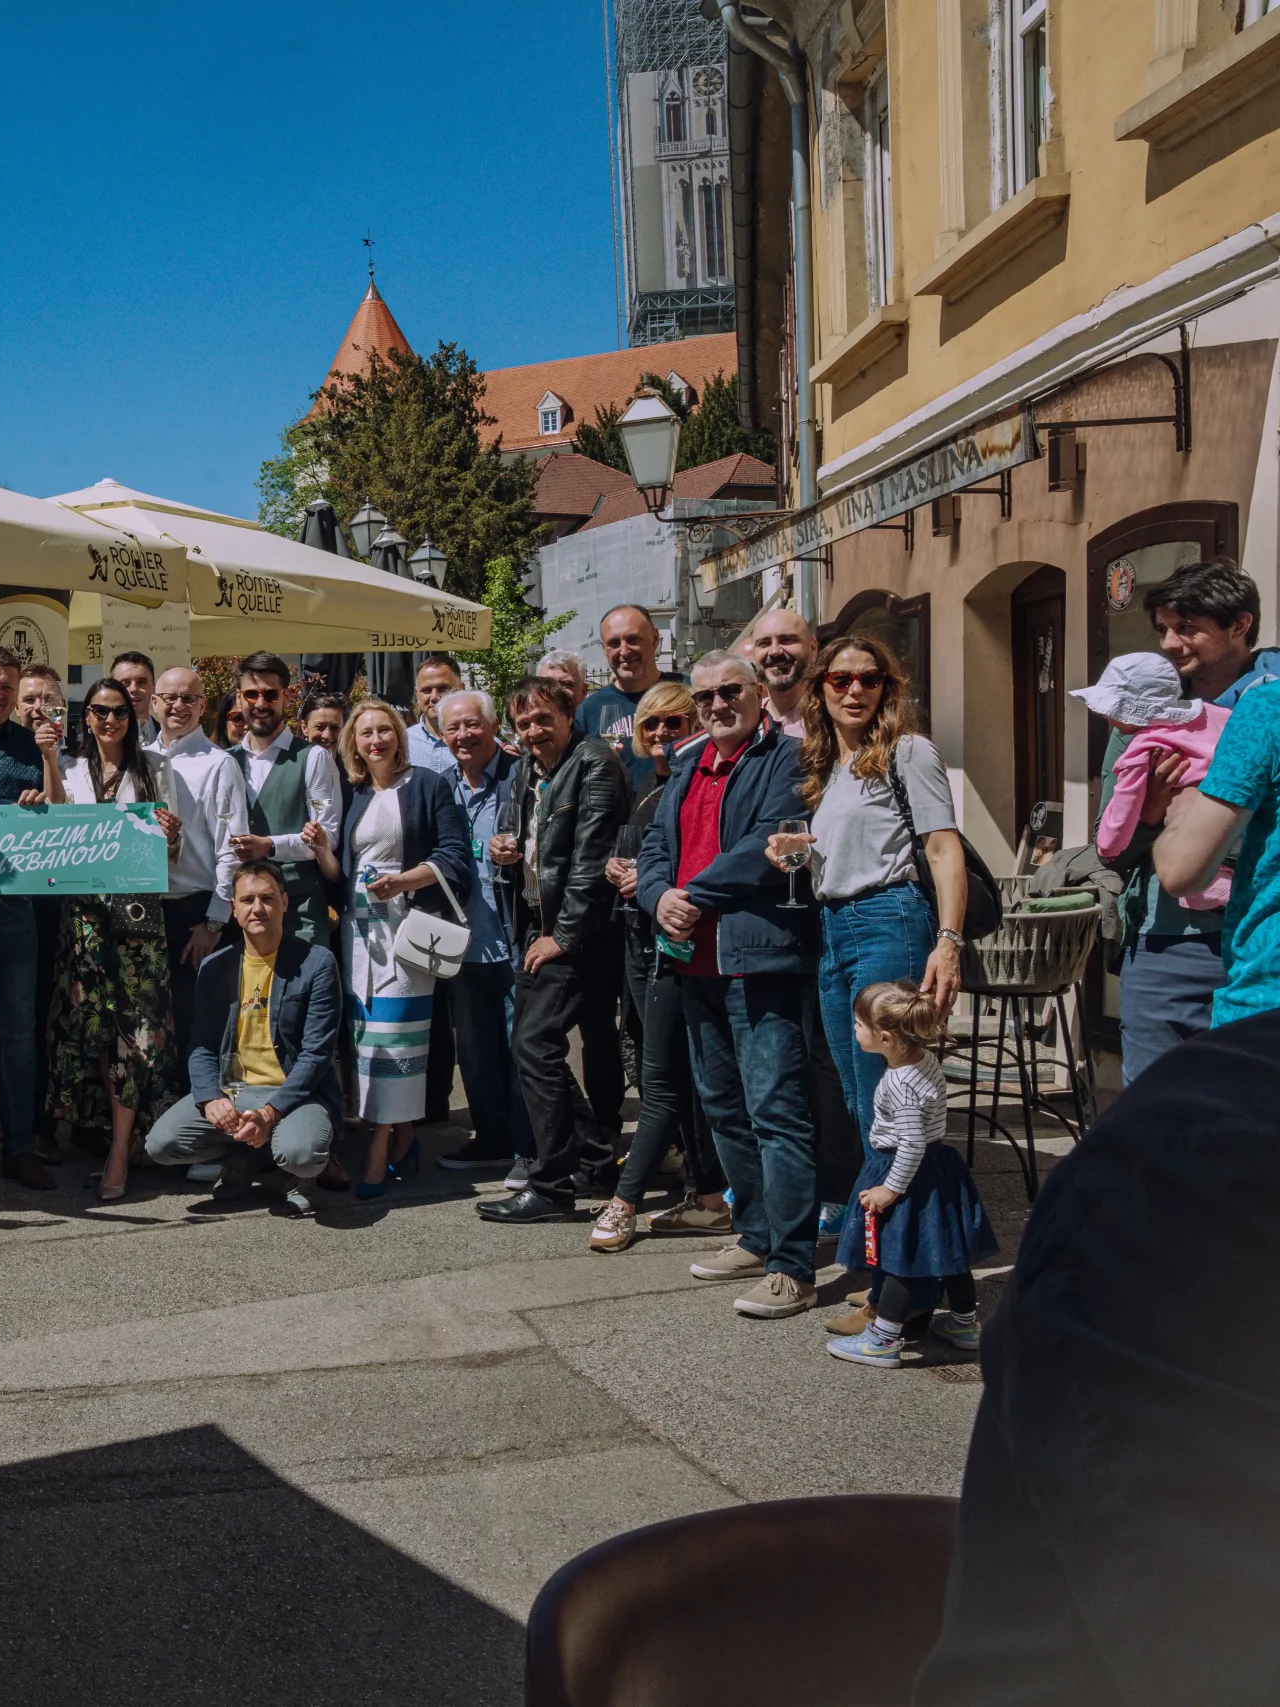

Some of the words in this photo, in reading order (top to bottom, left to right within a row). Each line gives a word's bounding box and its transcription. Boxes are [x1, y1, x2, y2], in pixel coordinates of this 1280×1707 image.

[834, 488, 876, 529] VINA
[878, 482, 886, 511] I
[888, 435, 984, 507] MASLINA
[90, 819, 123, 842] NA
